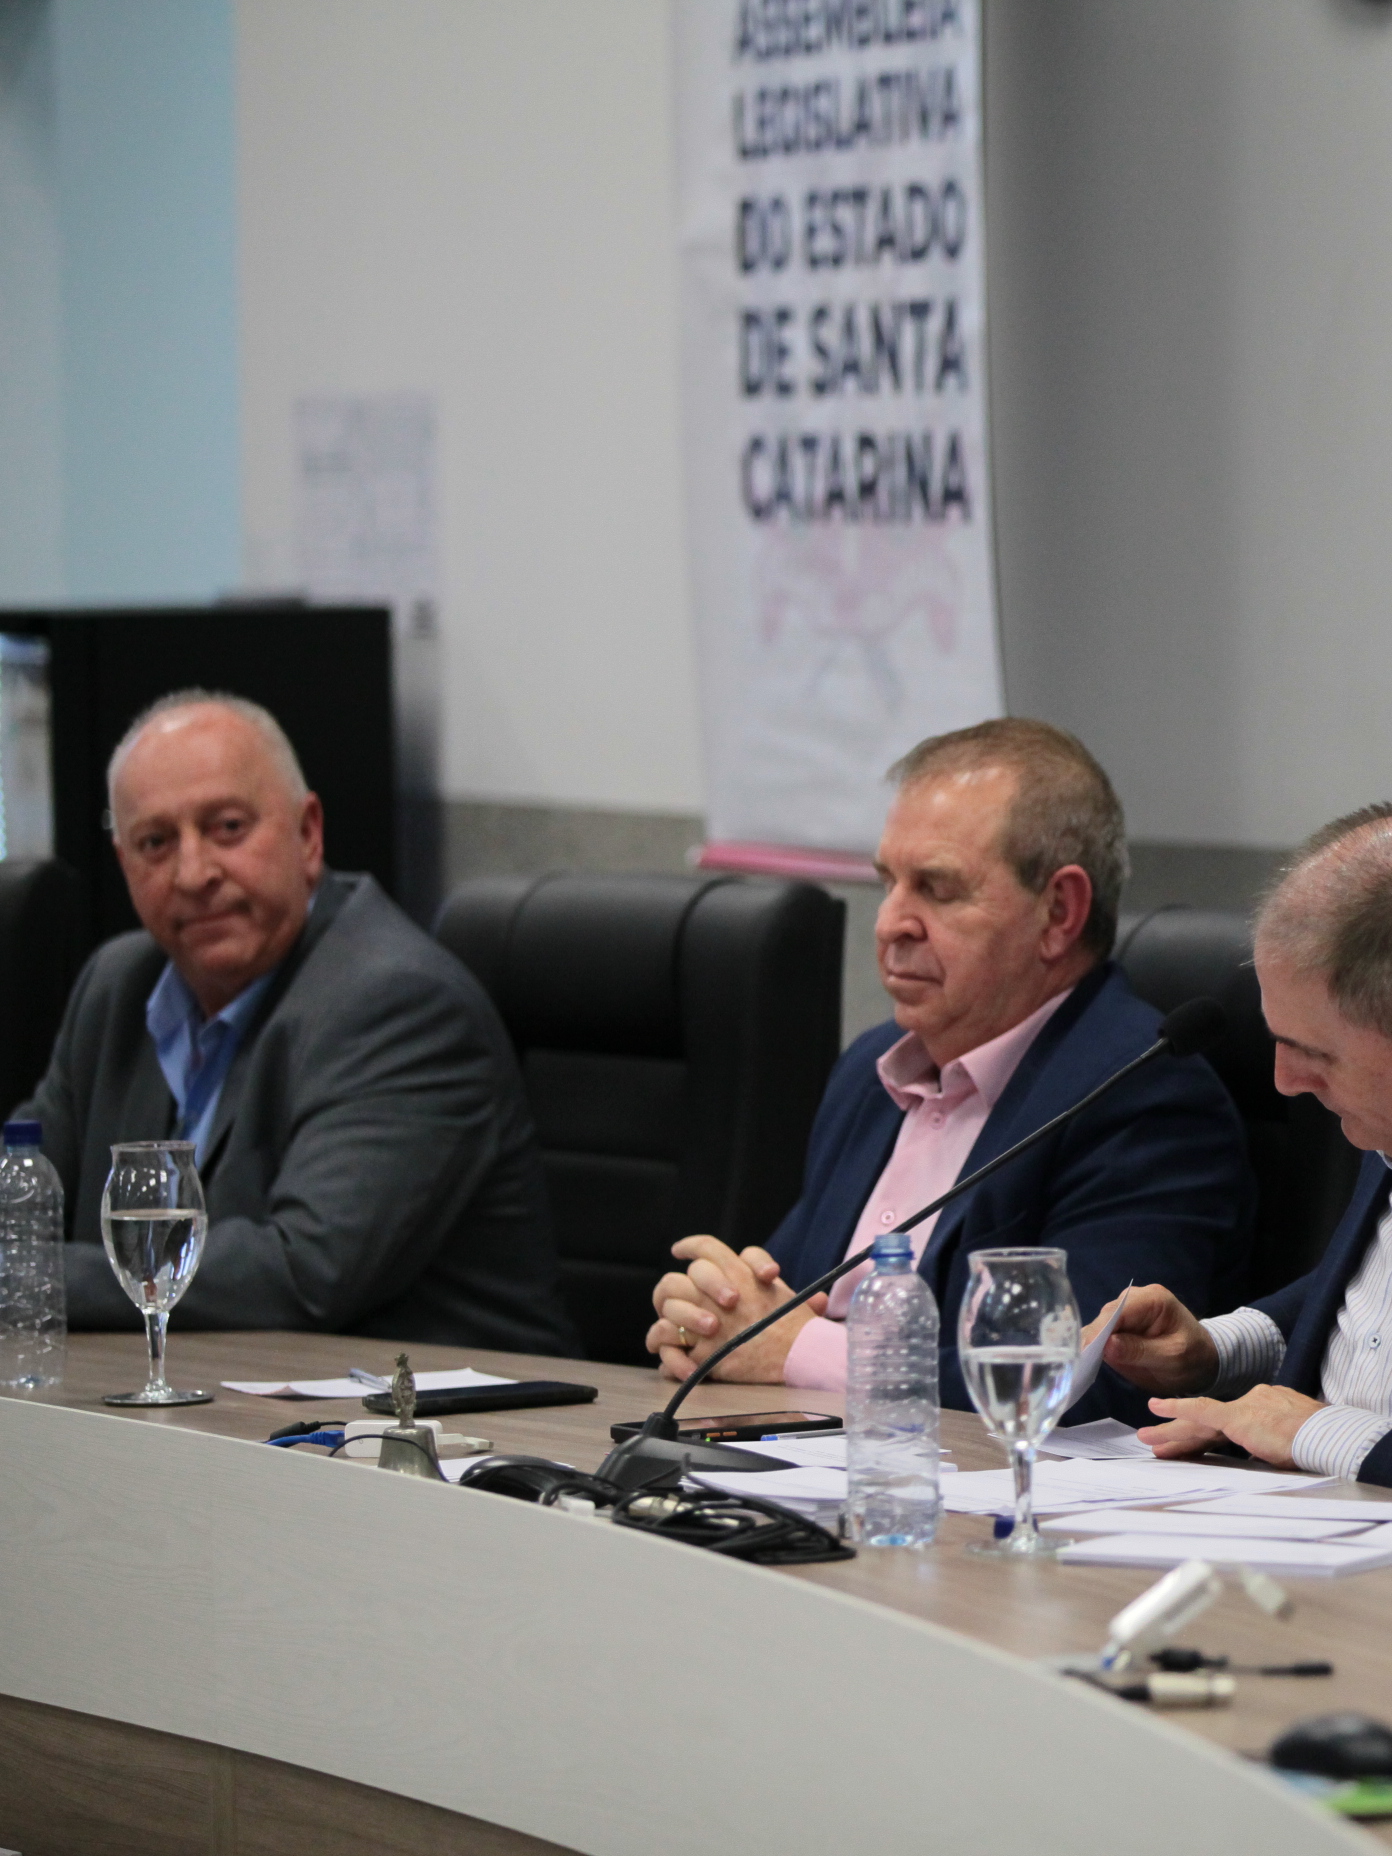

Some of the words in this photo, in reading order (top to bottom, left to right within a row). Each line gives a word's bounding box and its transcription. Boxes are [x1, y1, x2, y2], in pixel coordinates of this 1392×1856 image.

[734, 0, 964, 58] ASSEMBLEIA
[734, 68, 962, 161] LEGISLATIVA
[737, 195, 790, 275] DO
[805, 178, 967, 268] ESTADO
[740, 306, 796, 397] DE
[809, 298, 968, 397] SANTA
[742, 430, 971, 525] CATARINA
